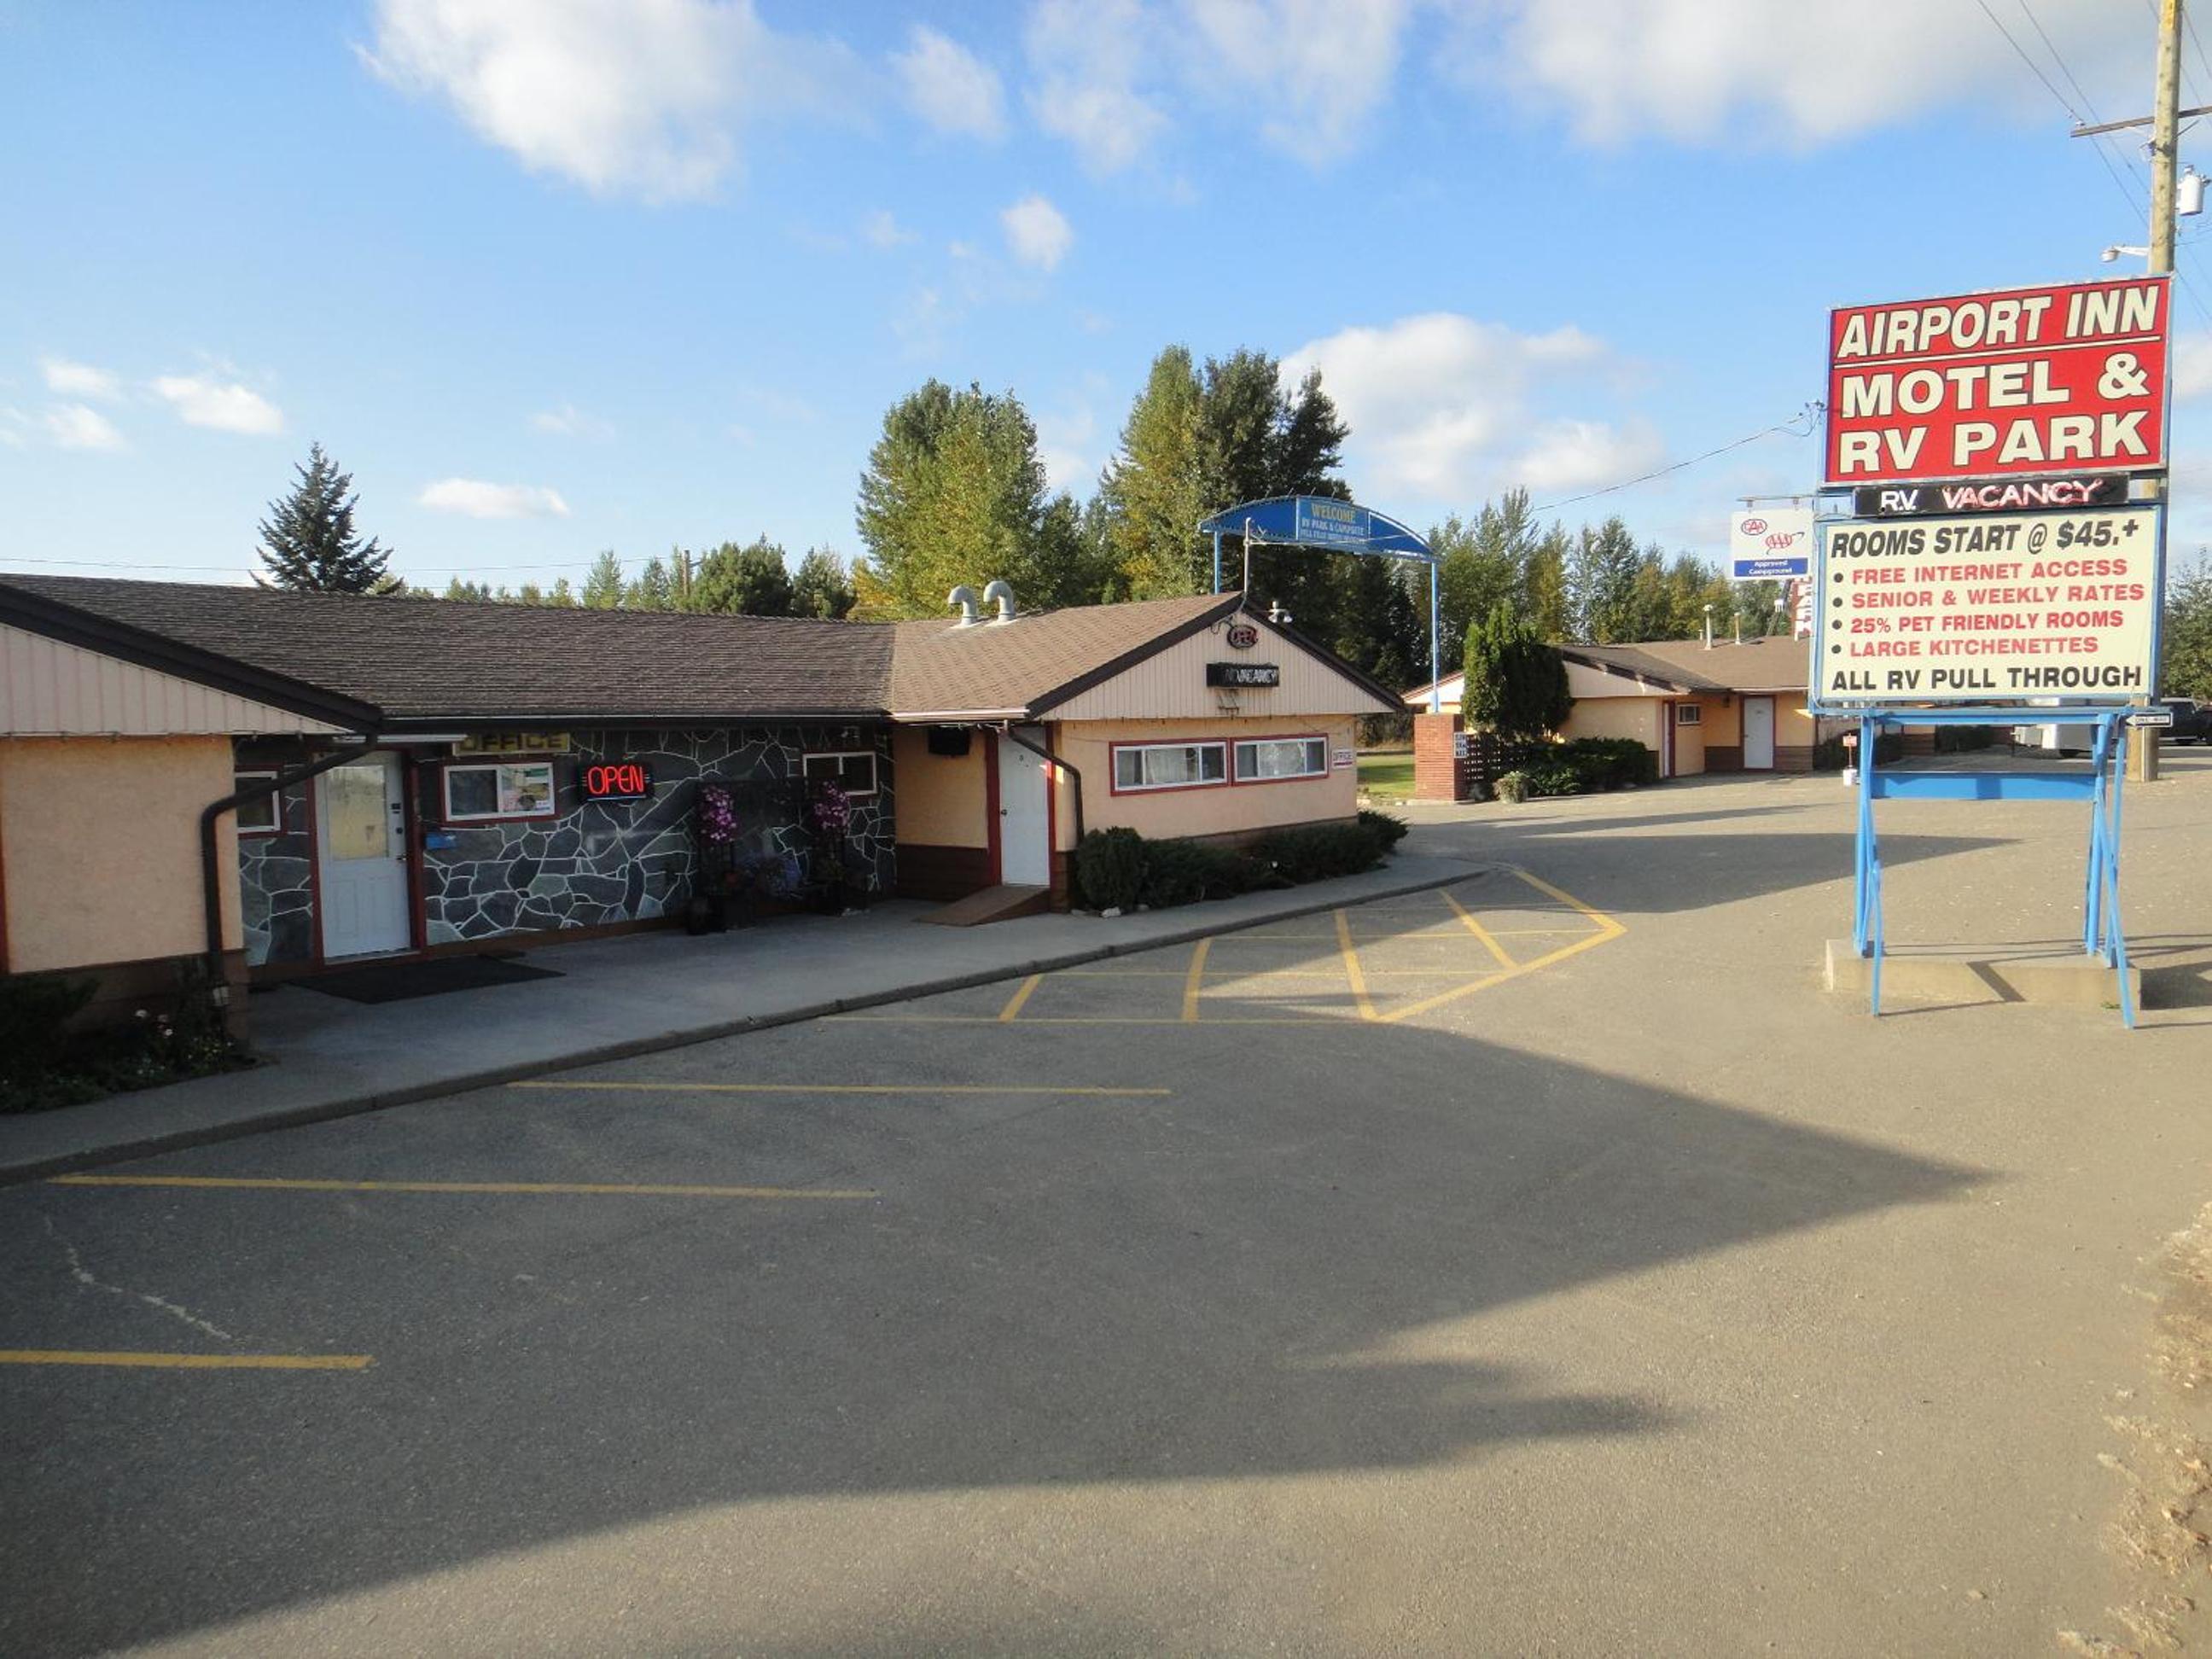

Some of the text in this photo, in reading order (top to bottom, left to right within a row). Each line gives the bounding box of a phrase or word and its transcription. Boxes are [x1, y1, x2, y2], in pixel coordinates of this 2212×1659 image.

[1837, 285, 2160, 358] AIRPORT INN
[1840, 352, 2151, 419] MOTEL &
[1839, 410, 2151, 474] RV PARK
[1941, 478, 2104, 509] VACANCY
[1311, 503, 1356, 524] WELCOME
[1831, 528, 1925, 558] ROOMS
[1934, 523, 2021, 555] START
[2027, 522, 2048, 554] @
[1852, 558, 2128, 585] FREE INTERNET ACCESS
[1852, 584, 2145, 609] SENIOR & WEEKLY RATES
[1850, 610, 2124, 633] 25% PET FRIENDLY ROOMS
[1849, 636, 2099, 657] LARGE KITCHENETTES
[1832, 666, 2142, 690] ALL RV PULL THROUGH
[460, 734, 563, 751] OFFICE
[587, 765, 644, 795] OPEN
